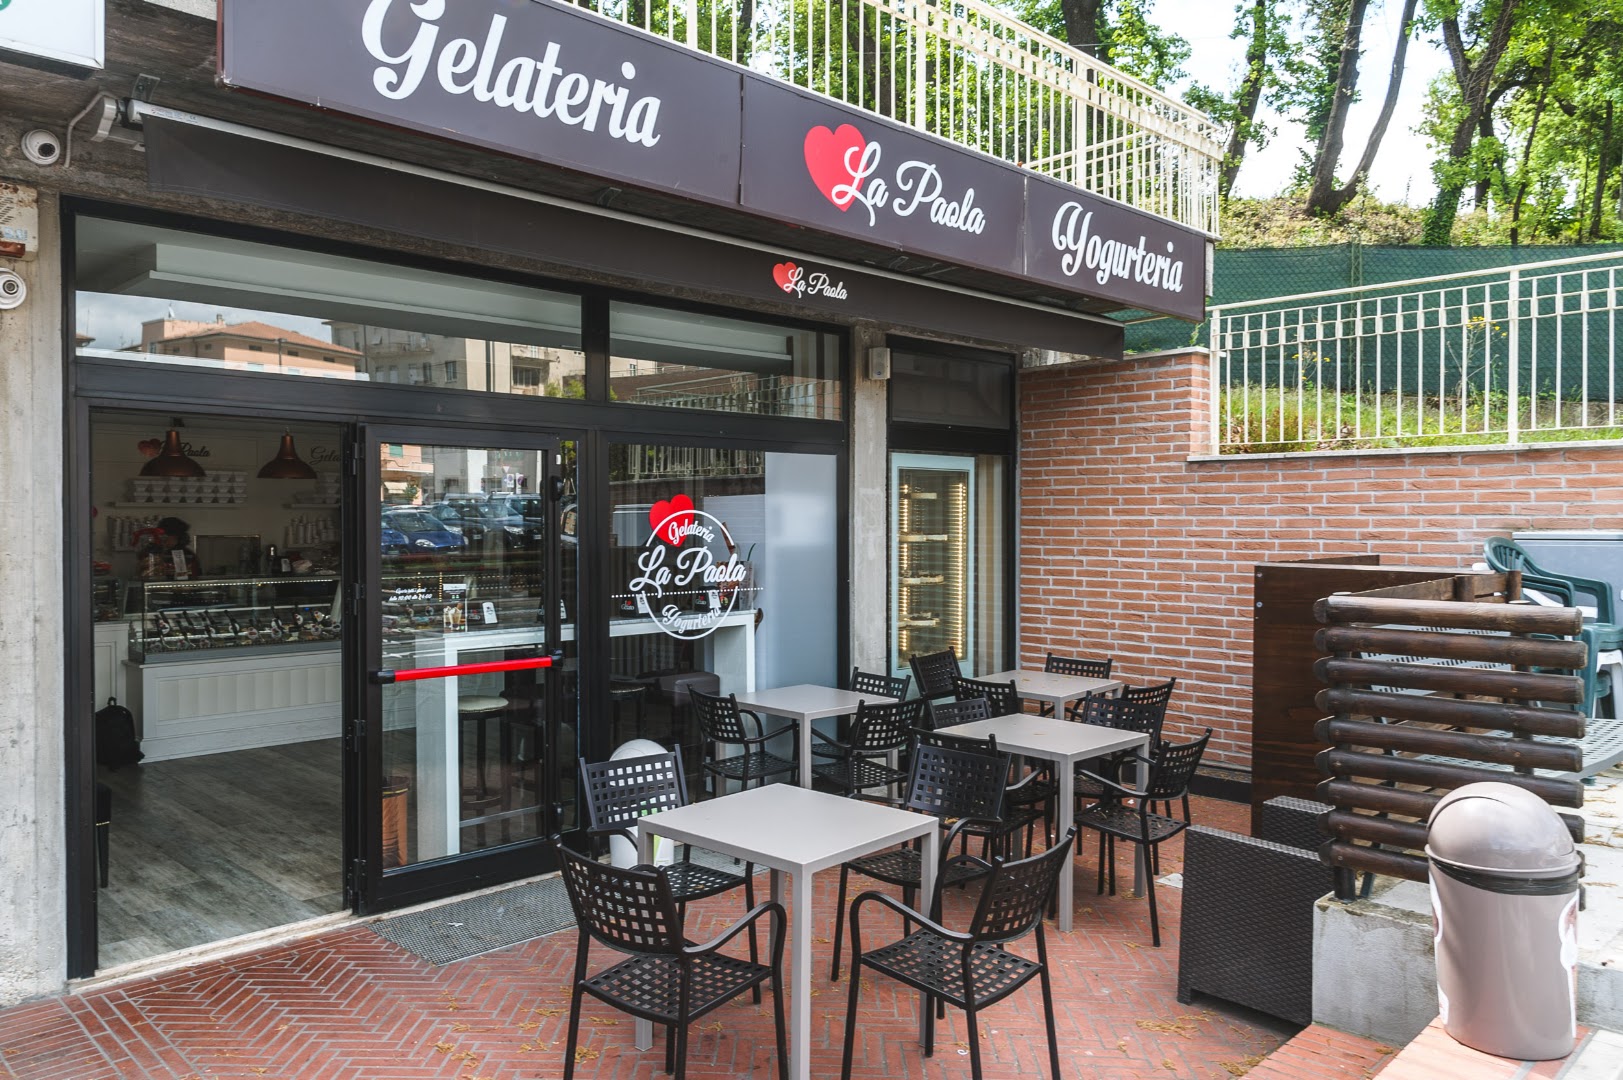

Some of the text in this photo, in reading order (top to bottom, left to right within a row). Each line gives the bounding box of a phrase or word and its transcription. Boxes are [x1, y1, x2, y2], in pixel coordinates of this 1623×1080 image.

[361, 0, 662, 148] Gelateria
[831, 140, 986, 235] La Paola
[1051, 200, 1184, 293] Yogurteria
[783, 266, 848, 300] La Paola
[309, 445, 342, 466] Gela
[667, 518, 716, 545] Gelateria
[629, 544, 747, 599] La Paola
[661, 604, 722, 634] Yogurteria
